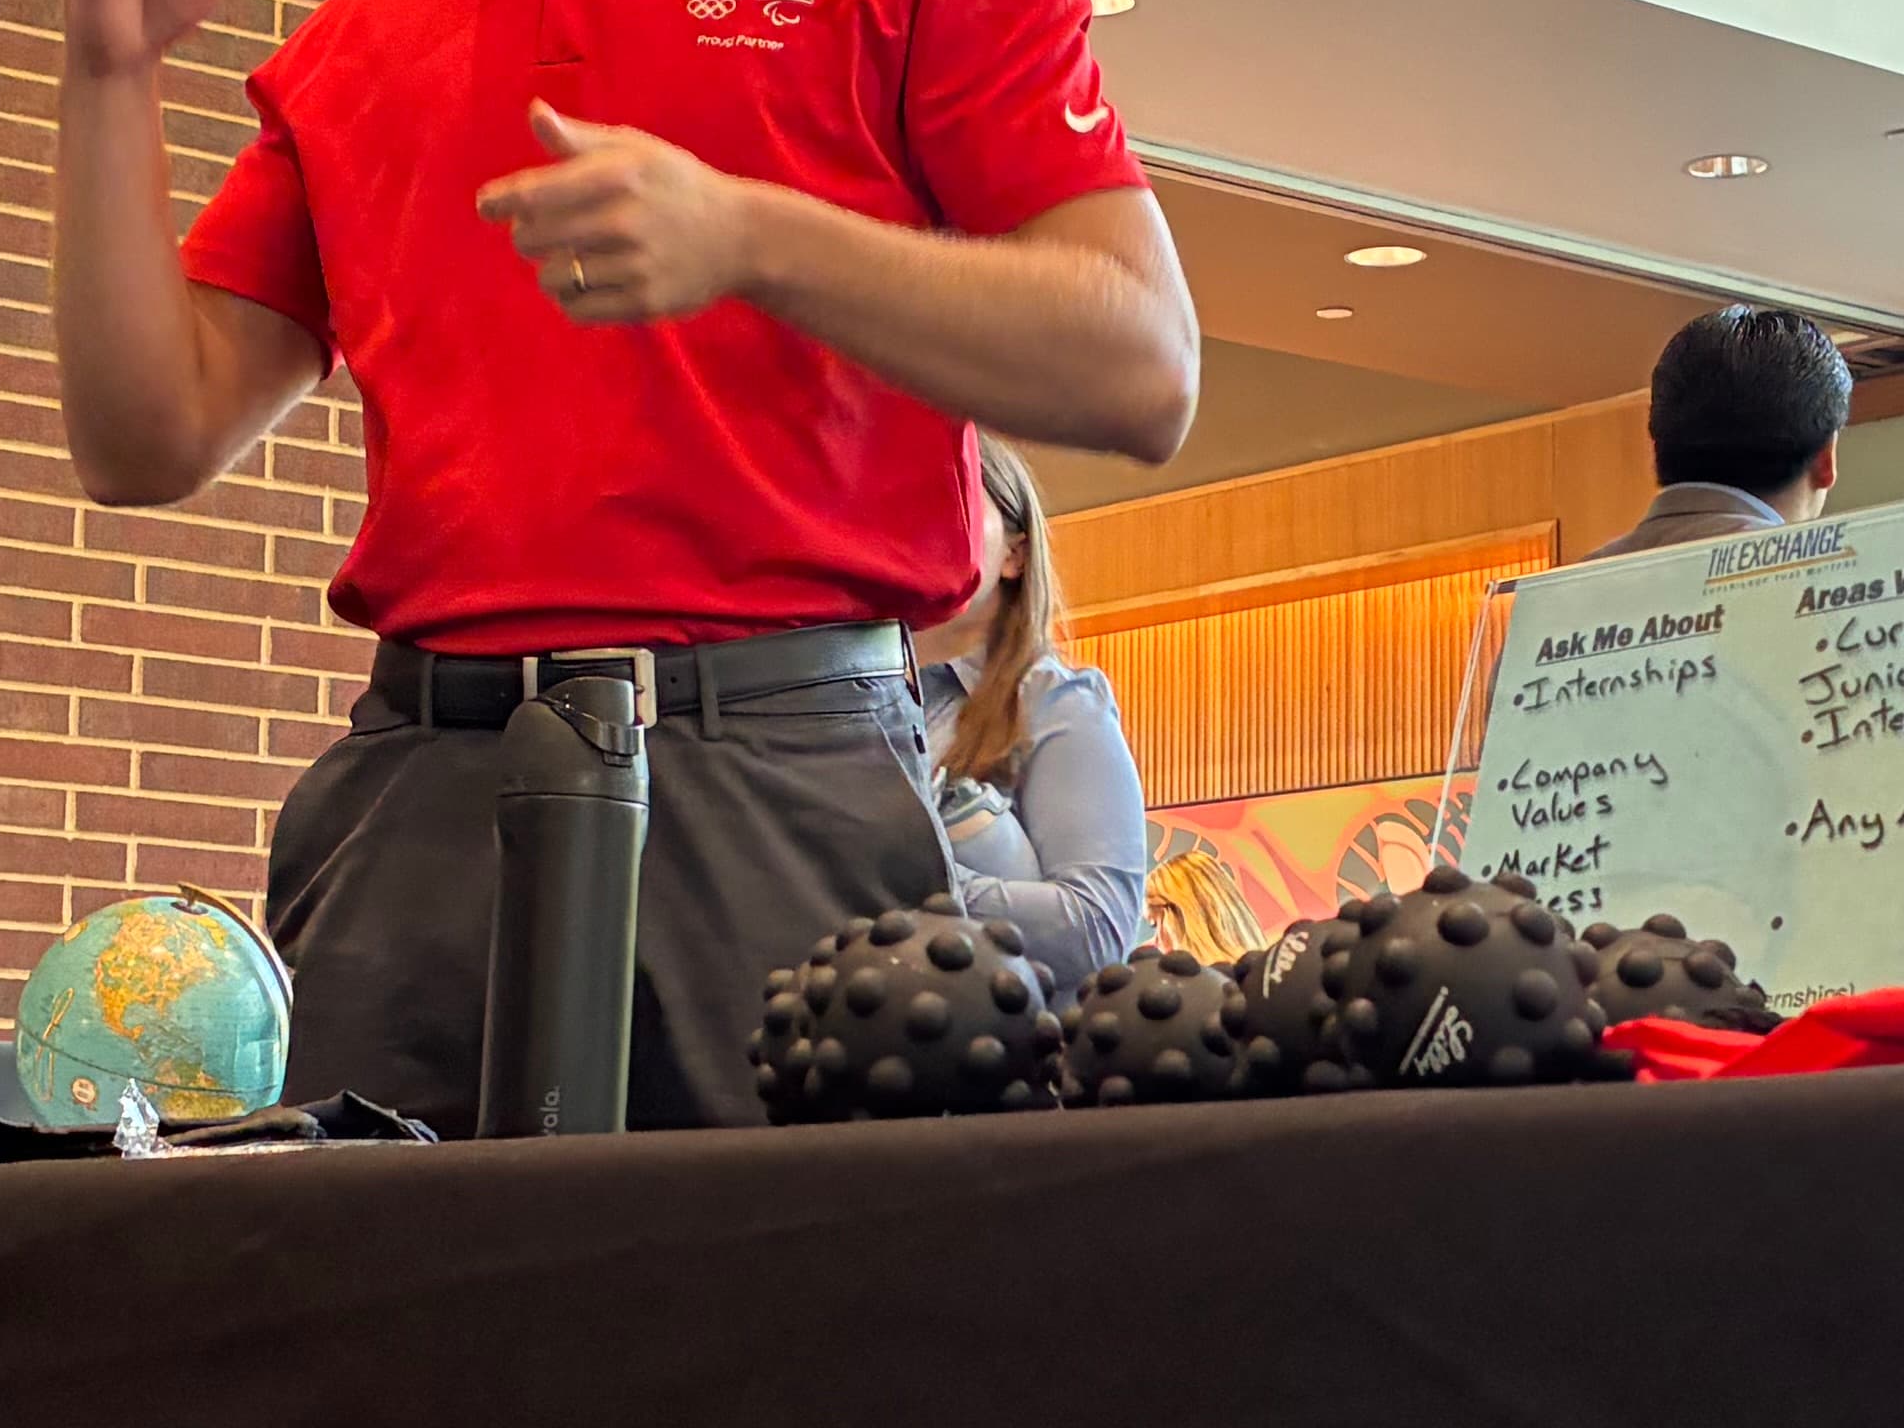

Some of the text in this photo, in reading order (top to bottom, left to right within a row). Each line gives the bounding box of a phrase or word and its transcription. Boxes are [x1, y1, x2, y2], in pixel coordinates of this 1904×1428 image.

[1708, 522, 1847, 578] THE EXCHANGE
[1795, 579, 1885, 615] Areas
[1535, 604, 1725, 663] Ask Me About
[1522, 655, 1718, 712] Internships
[1511, 753, 1669, 795] Company
[1512, 792, 1614, 828] Values
[1801, 799, 1885, 850] Any
[1498, 833, 1611, 878] Market
[1413, 1005, 1474, 1077] Lilly
